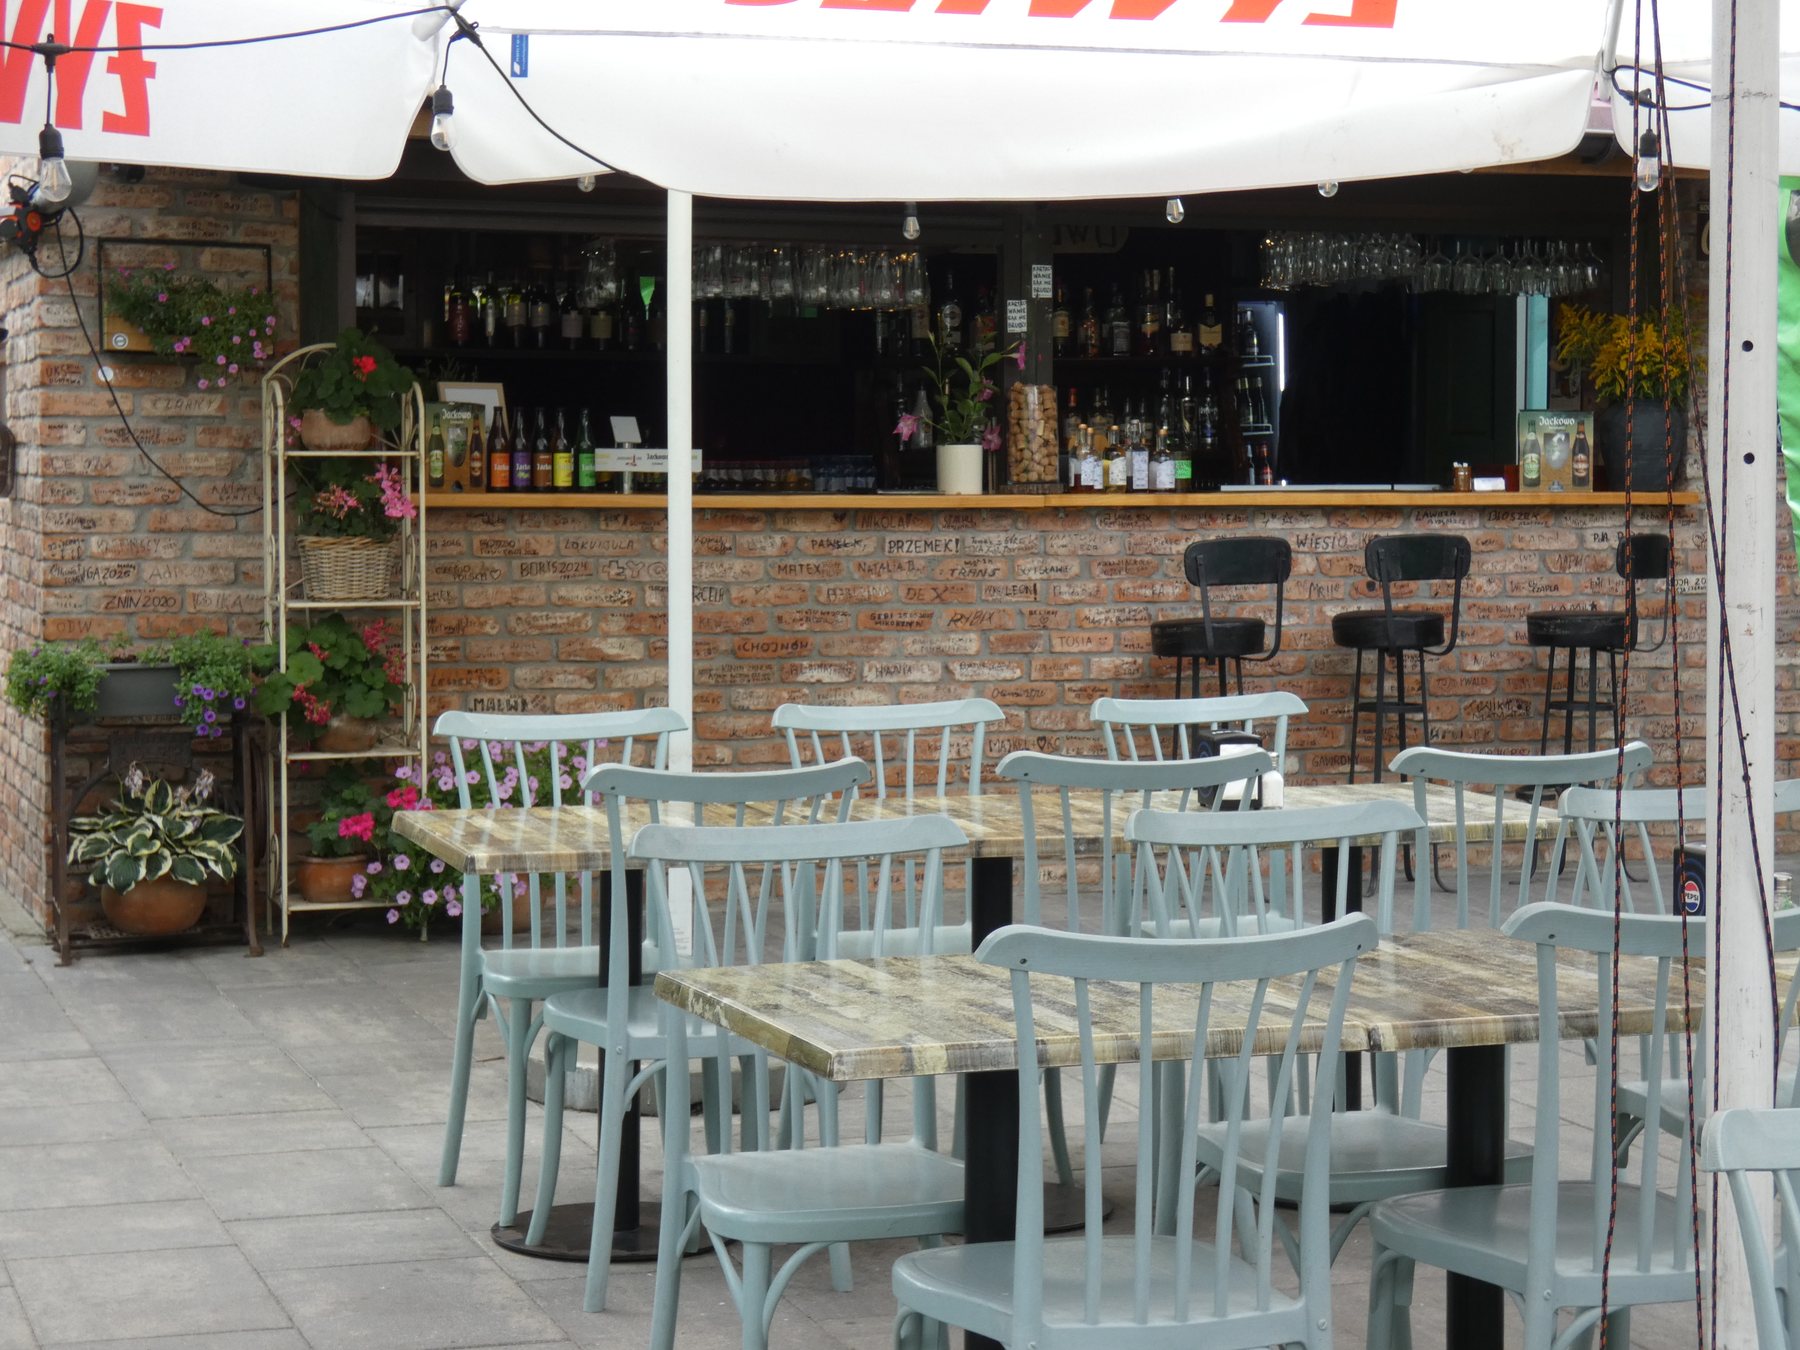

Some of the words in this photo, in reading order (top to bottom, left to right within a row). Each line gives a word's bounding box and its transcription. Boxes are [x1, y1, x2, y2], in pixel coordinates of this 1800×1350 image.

[1539, 415, 1575, 426] Jackowo
[888, 538, 960, 554] PRZEMEK!
[1058, 636, 1092, 648] TOSIA
